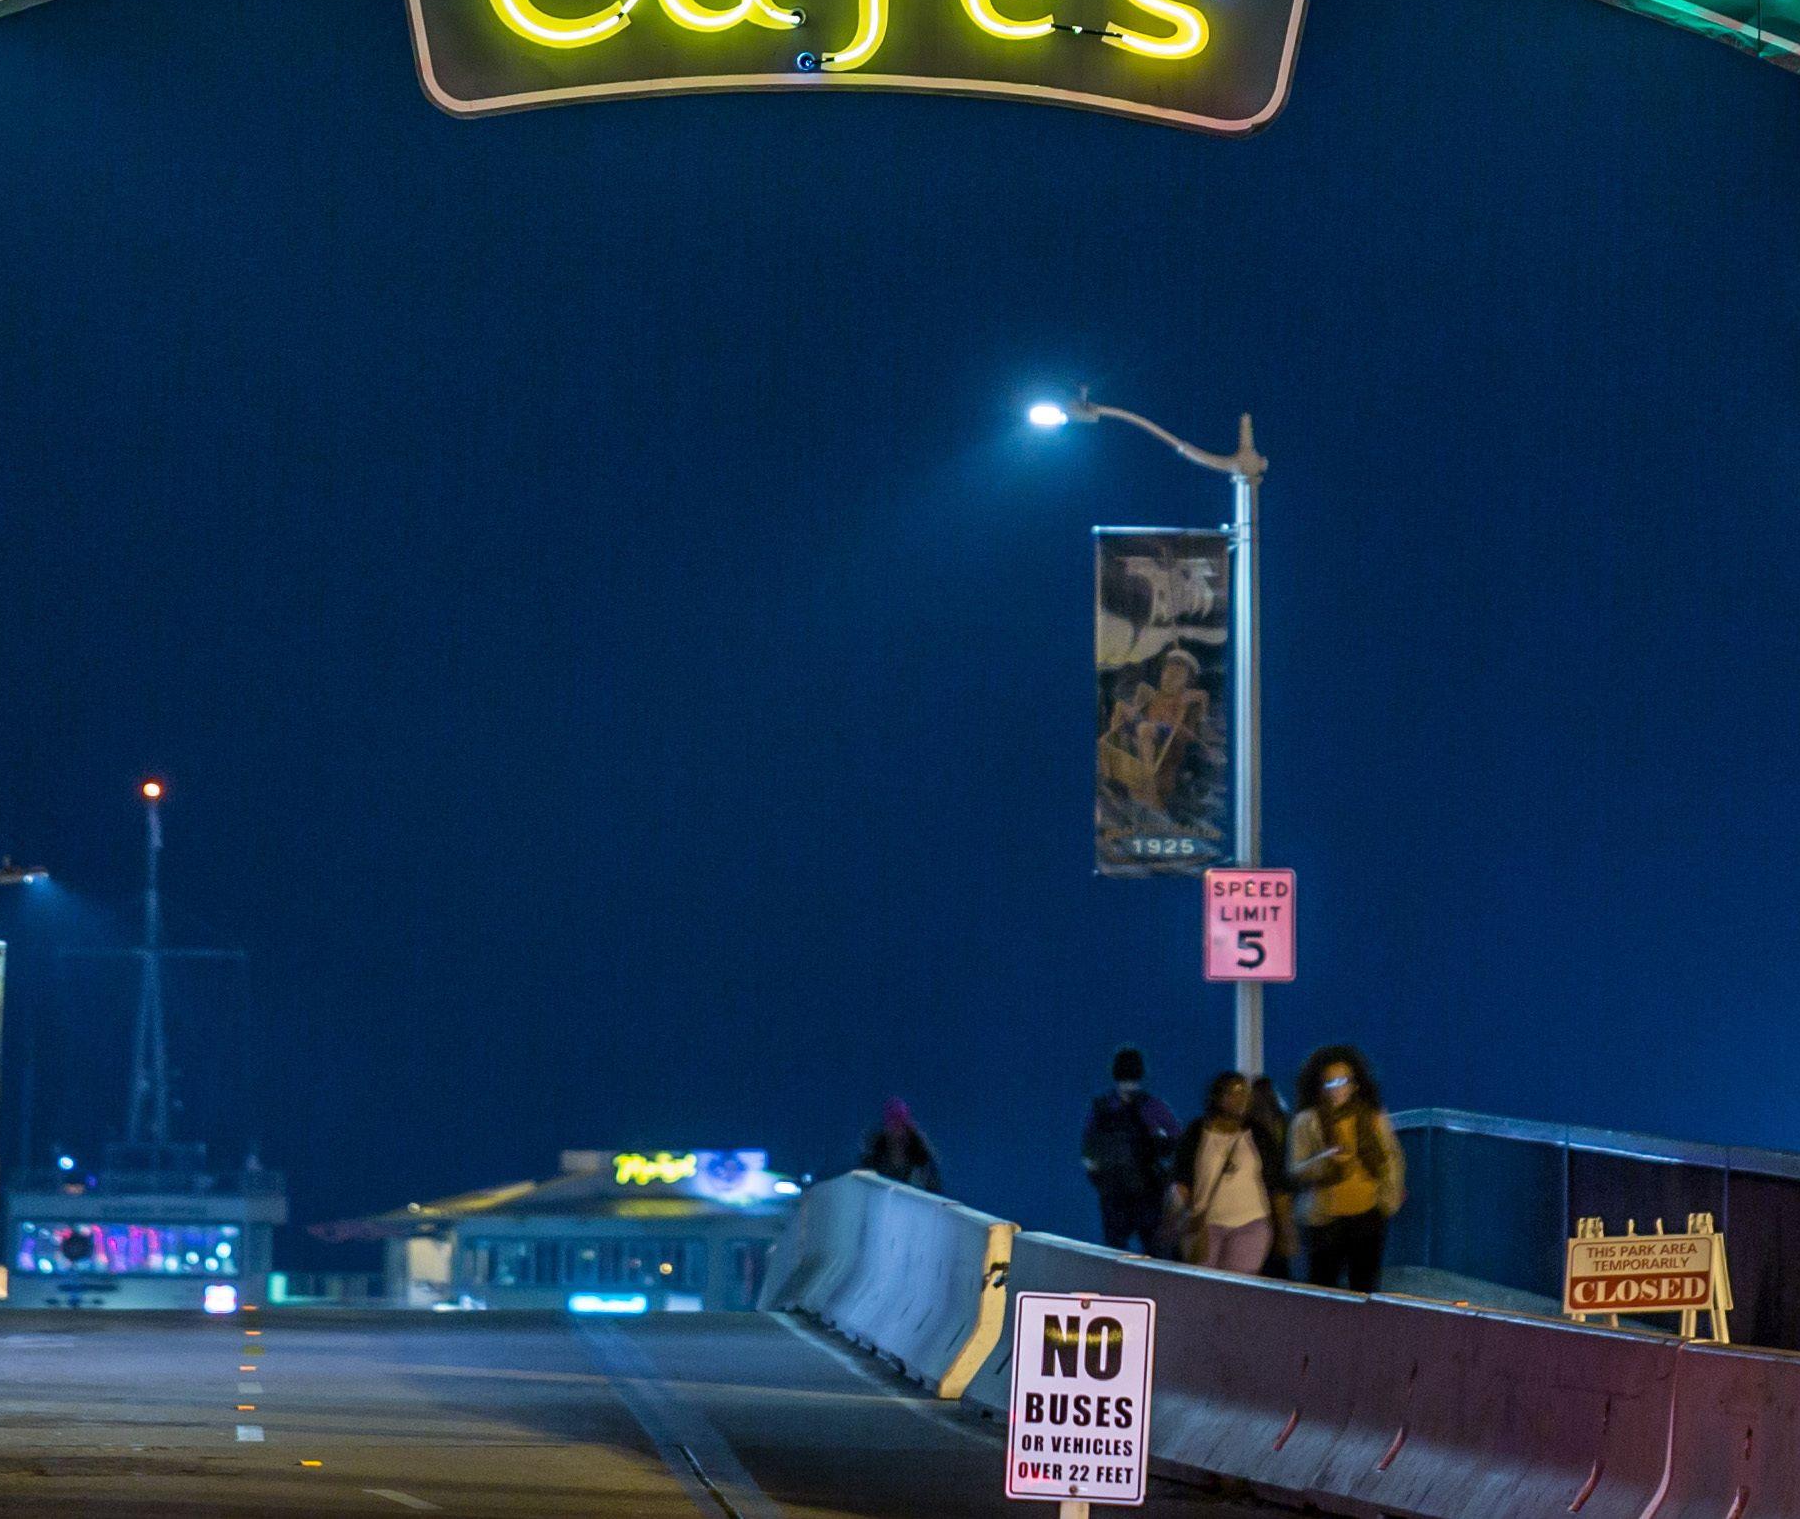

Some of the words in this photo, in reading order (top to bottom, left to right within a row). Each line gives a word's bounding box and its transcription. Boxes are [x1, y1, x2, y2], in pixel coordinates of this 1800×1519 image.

[1133, 838, 1195, 855] 1925
[1214, 882, 1287, 897] SPEED
[1221, 907, 1280, 921] LIMIT
[1237, 930, 1265, 968] 5
[1587, 1246, 1616, 1258] THIS
[1620, 1244, 1656, 1256] PARK
[1660, 1243, 1697, 1255] AREA
[1593, 1257, 1689, 1271] TEMPORARILY
[1574, 1277, 1706, 1303] CLOSED
[1041, 1314, 1123, 1381] NO
[1025, 1393, 1133, 1429] BUSES
[1022, 1434, 1044, 1451] OR
[1051, 1436, 1133, 1456] VEHICLES
[1018, 1462, 1062, 1480] OVER
[1069, 1465, 1090, 1481] 22
[1097, 1467, 1133, 1484] FEET
